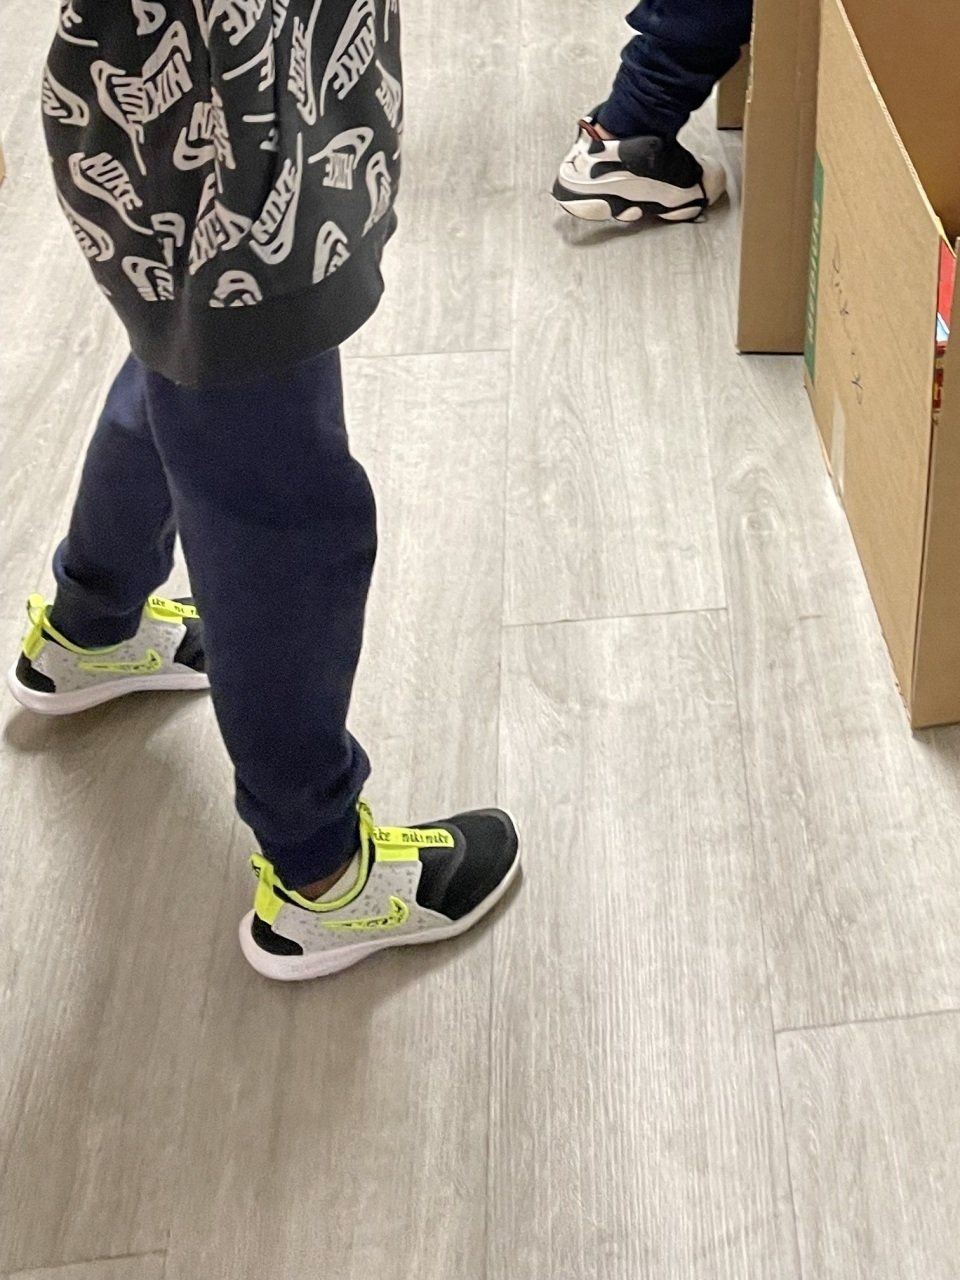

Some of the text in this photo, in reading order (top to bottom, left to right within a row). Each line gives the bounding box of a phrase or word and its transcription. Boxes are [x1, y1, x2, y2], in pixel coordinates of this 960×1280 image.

[333, 16, 376, 100] NIKE
[80, 152, 143, 210] NIKE
[251, 158, 297, 243] NIKE
